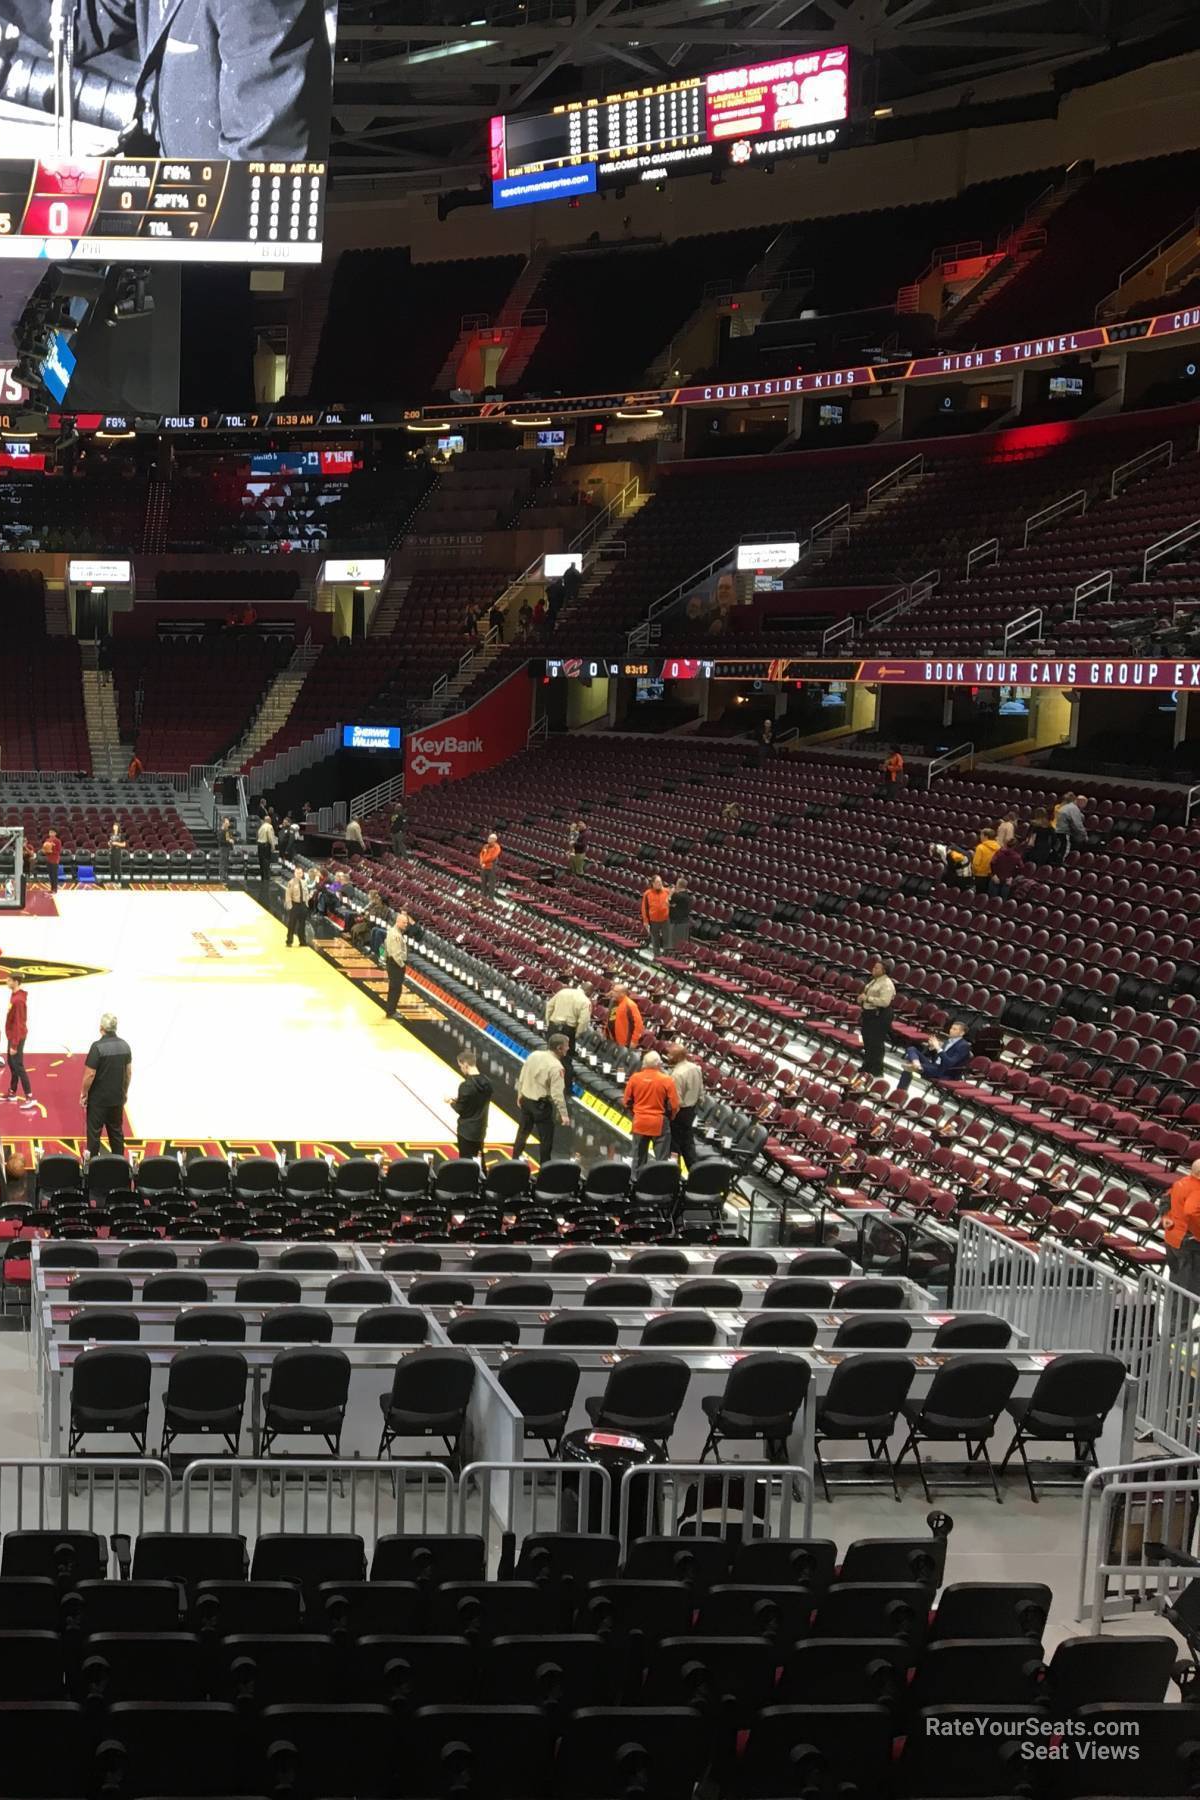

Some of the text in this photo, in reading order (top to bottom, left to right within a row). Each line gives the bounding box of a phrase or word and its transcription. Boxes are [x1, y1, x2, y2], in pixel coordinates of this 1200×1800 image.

[755, 129, 836, 155] WESTFIELD
[599, 145, 713, 174] WELCOME TO QUICKEN LOANS
[202, 166, 212, 181] 0
[641, 168, 668, 181] ARENA
[121, 192, 132, 209] 0
[197, 193, 207, 207] 0
[48, 202, 68, 234] 0
[189, 221, 199, 236] 7
[943, 336, 1078, 371] HIGH 5 TUNNEL
[704, 371, 854, 400] COURTSIDE KIDS
[105, 417, 126, 428] FG%
[165, 417, 209, 428] FOULS 0
[225, 415, 259, 427] TOL: 7
[276, 415, 314, 425] 11:39 AM
[326, 415, 341, 424] DAL
[360, 414, 374, 422] MIL
[417, 536, 482, 545] WESTFIELD
[552, 667, 558, 677] 0
[590, 663, 597, 676] 0
[625, 665, 648, 674] 83:15
[671, 663, 679, 677] 0
[706, 668, 711, 678] 0
[925, 663, 964, 681] BOOK
[976, 663, 1018, 682] YOUR
[1030, 663, 1076, 683] CAVS
[1090, 664, 1158, 685] GROUP
[411, 737, 483, 756] KeyBank
